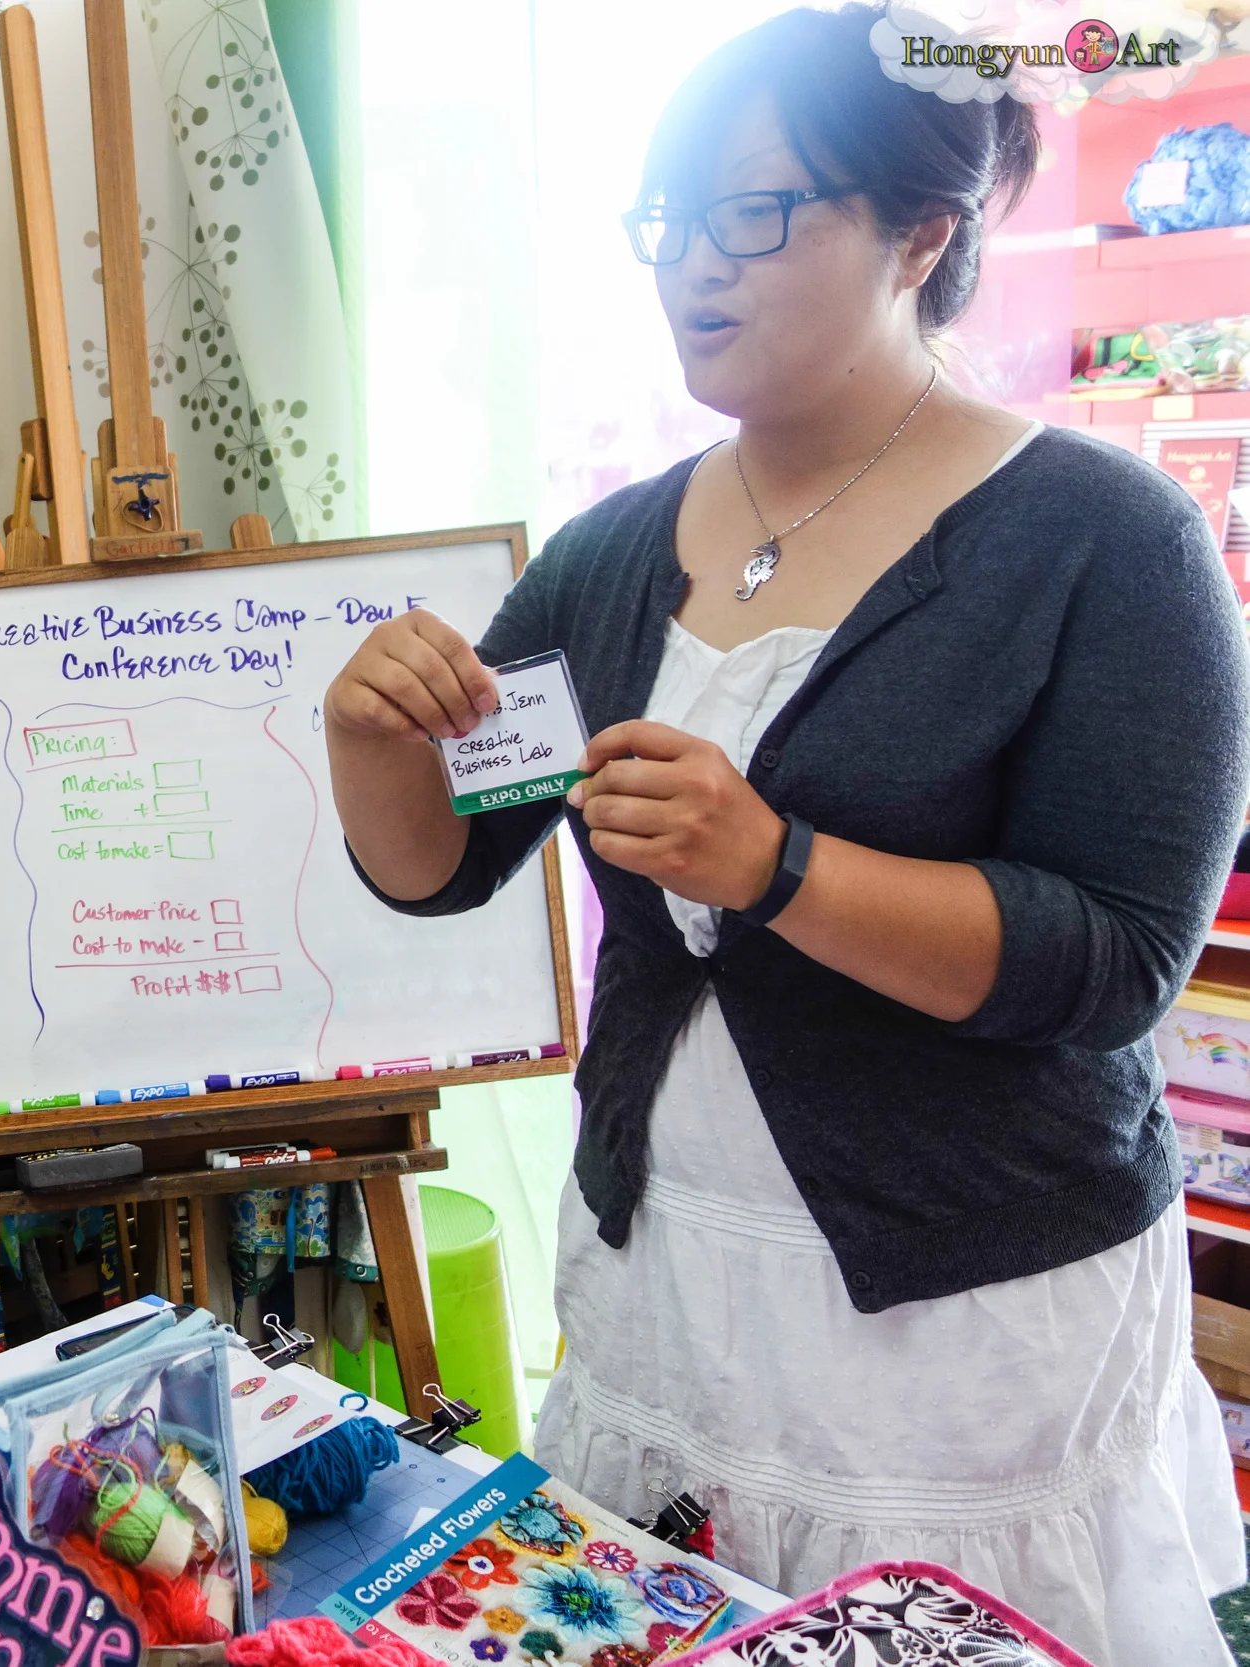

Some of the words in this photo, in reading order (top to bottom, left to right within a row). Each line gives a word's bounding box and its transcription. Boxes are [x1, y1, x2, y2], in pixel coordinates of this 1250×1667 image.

[235, 598, 306, 632] Camp
[224, 640, 294, 687] Day!
[519, 742, 553, 764] Lab
[62, 770, 145, 793] Materials
[479, 787, 521, 807] EXPO
[525, 778, 566, 797] ONLY
[59, 802, 104, 822] Time
[57, 841, 89, 860] Cost
[72, 900, 151, 923] Customer
[160, 900, 201, 921] Price
[72, 935, 110, 955] Cost
[117, 937, 132, 954] to
[140, 936, 185, 956] make
[131, 975, 192, 997] Profit
[244, 1076, 276, 1088] EXPO
[133, 1086, 165, 1101] EXPO
[354, 1531, 448, 1604] Crocheted
[440, 1487, 507, 1538] Flowers
[334, 1599, 366, 1627] Make
